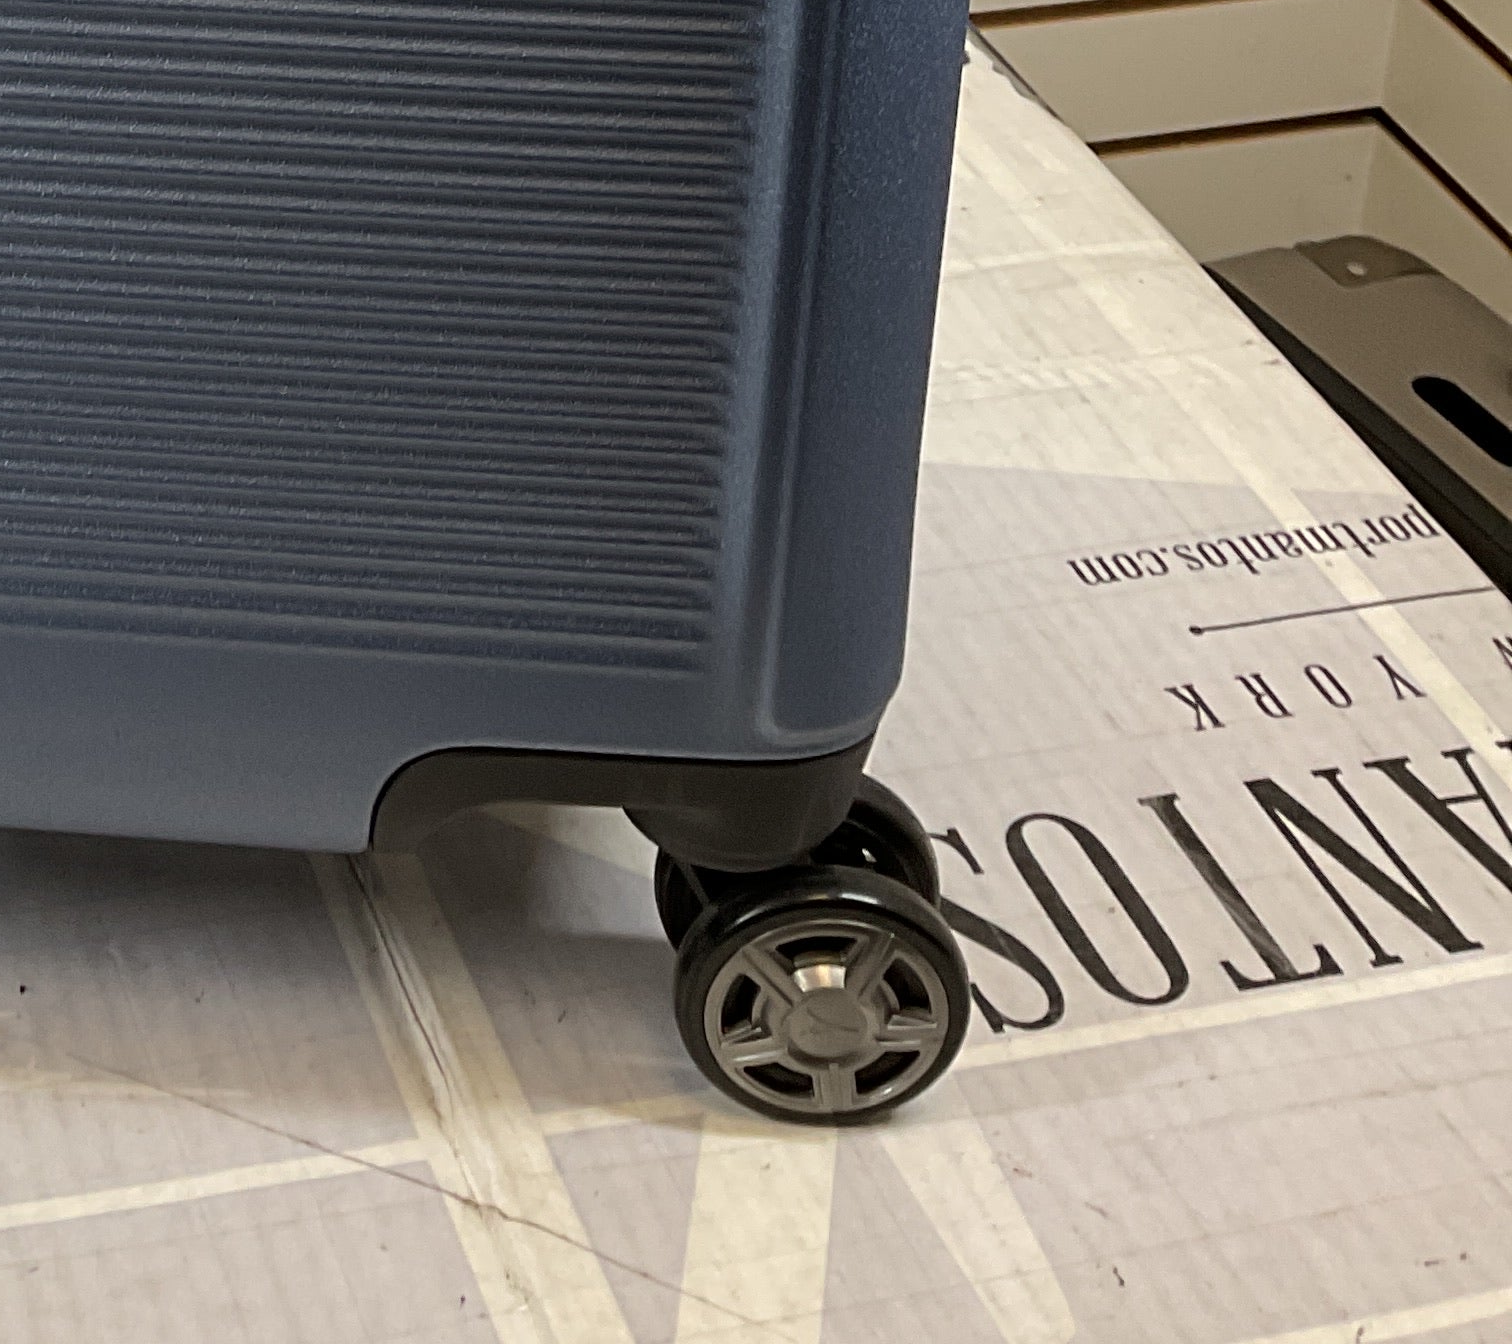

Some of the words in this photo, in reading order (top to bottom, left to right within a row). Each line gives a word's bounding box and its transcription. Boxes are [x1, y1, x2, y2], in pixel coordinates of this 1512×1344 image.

[1067, 503, 1442, 587] portmantos.com
[1164, 653, 1428, 732] YORK
[928, 736, 1512, 1034] ANTOS
